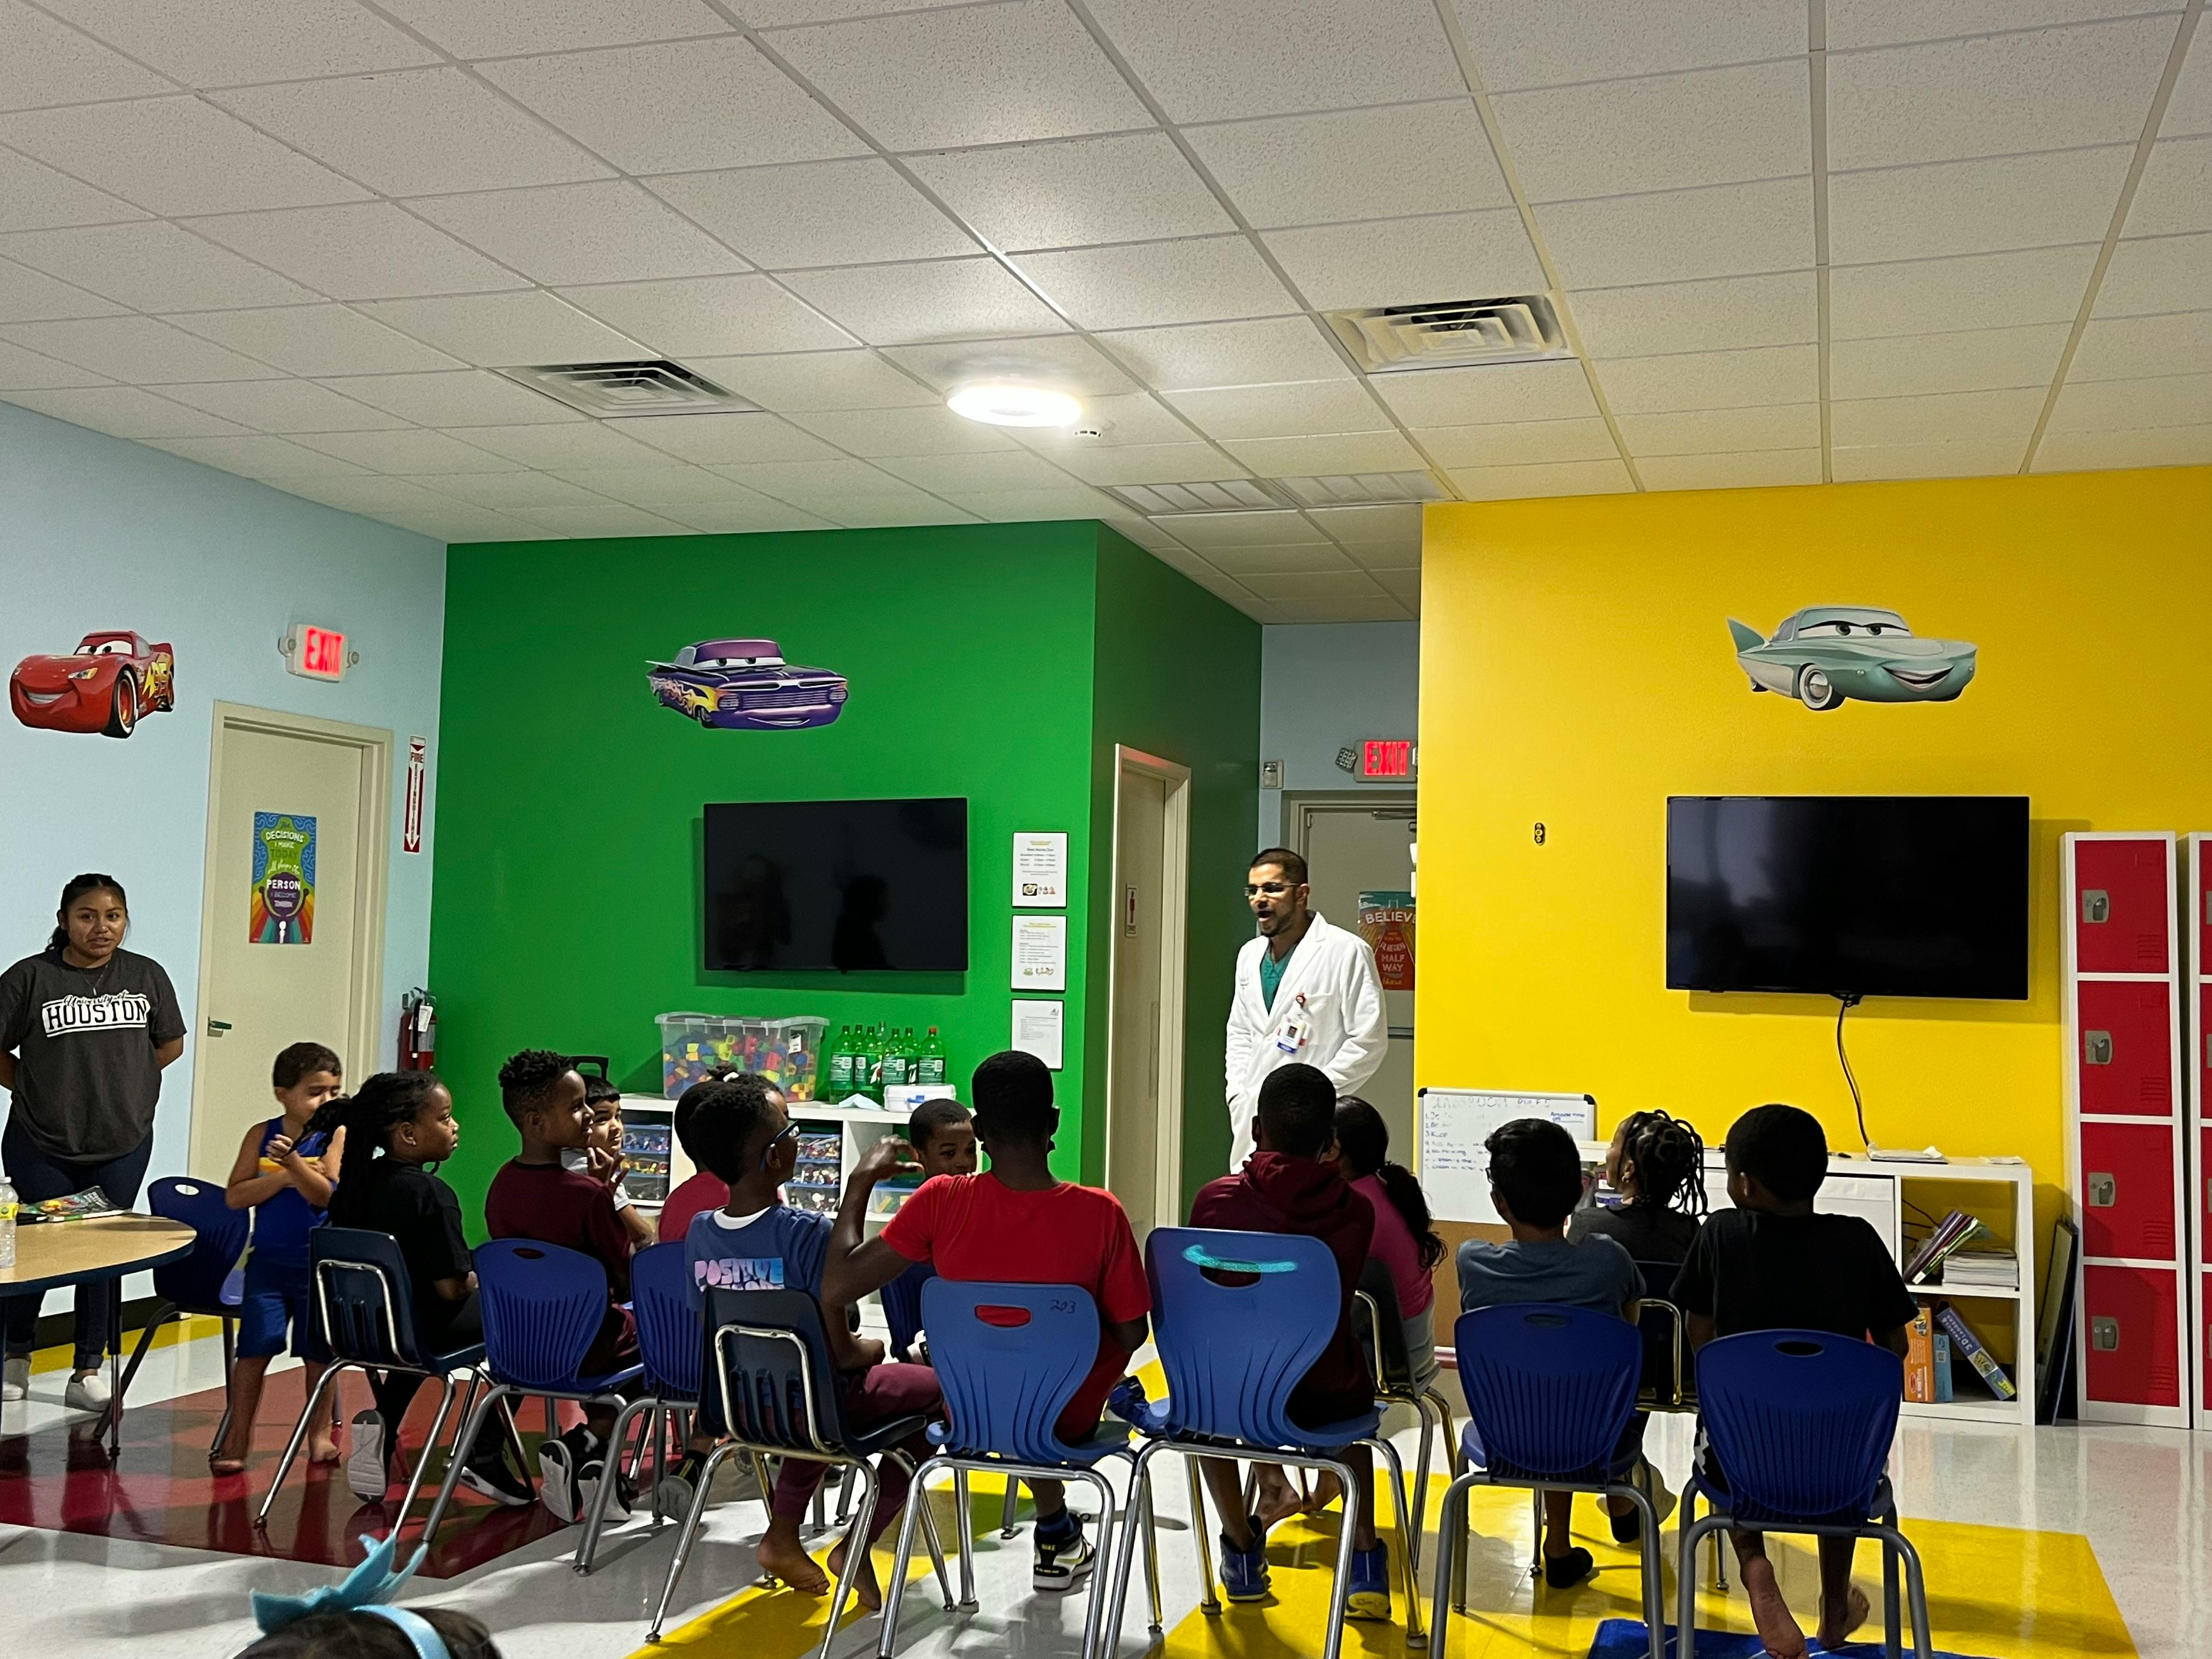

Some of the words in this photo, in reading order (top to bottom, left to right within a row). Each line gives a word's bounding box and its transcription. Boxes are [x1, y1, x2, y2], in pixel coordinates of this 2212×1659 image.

[304, 627, 344, 676] EXIT
[410, 752, 424, 763] FIRE
[1364, 741, 1410, 776] EXIT
[266, 830, 304, 843] DECISIONS
[267, 879, 301, 890] PERSON
[1381, 954, 1404, 962] HALF
[1383, 963, 1403, 972] WAY
[47, 1000, 148, 1030] HOUSTON
[1050, 1299, 1076, 1313] 203
